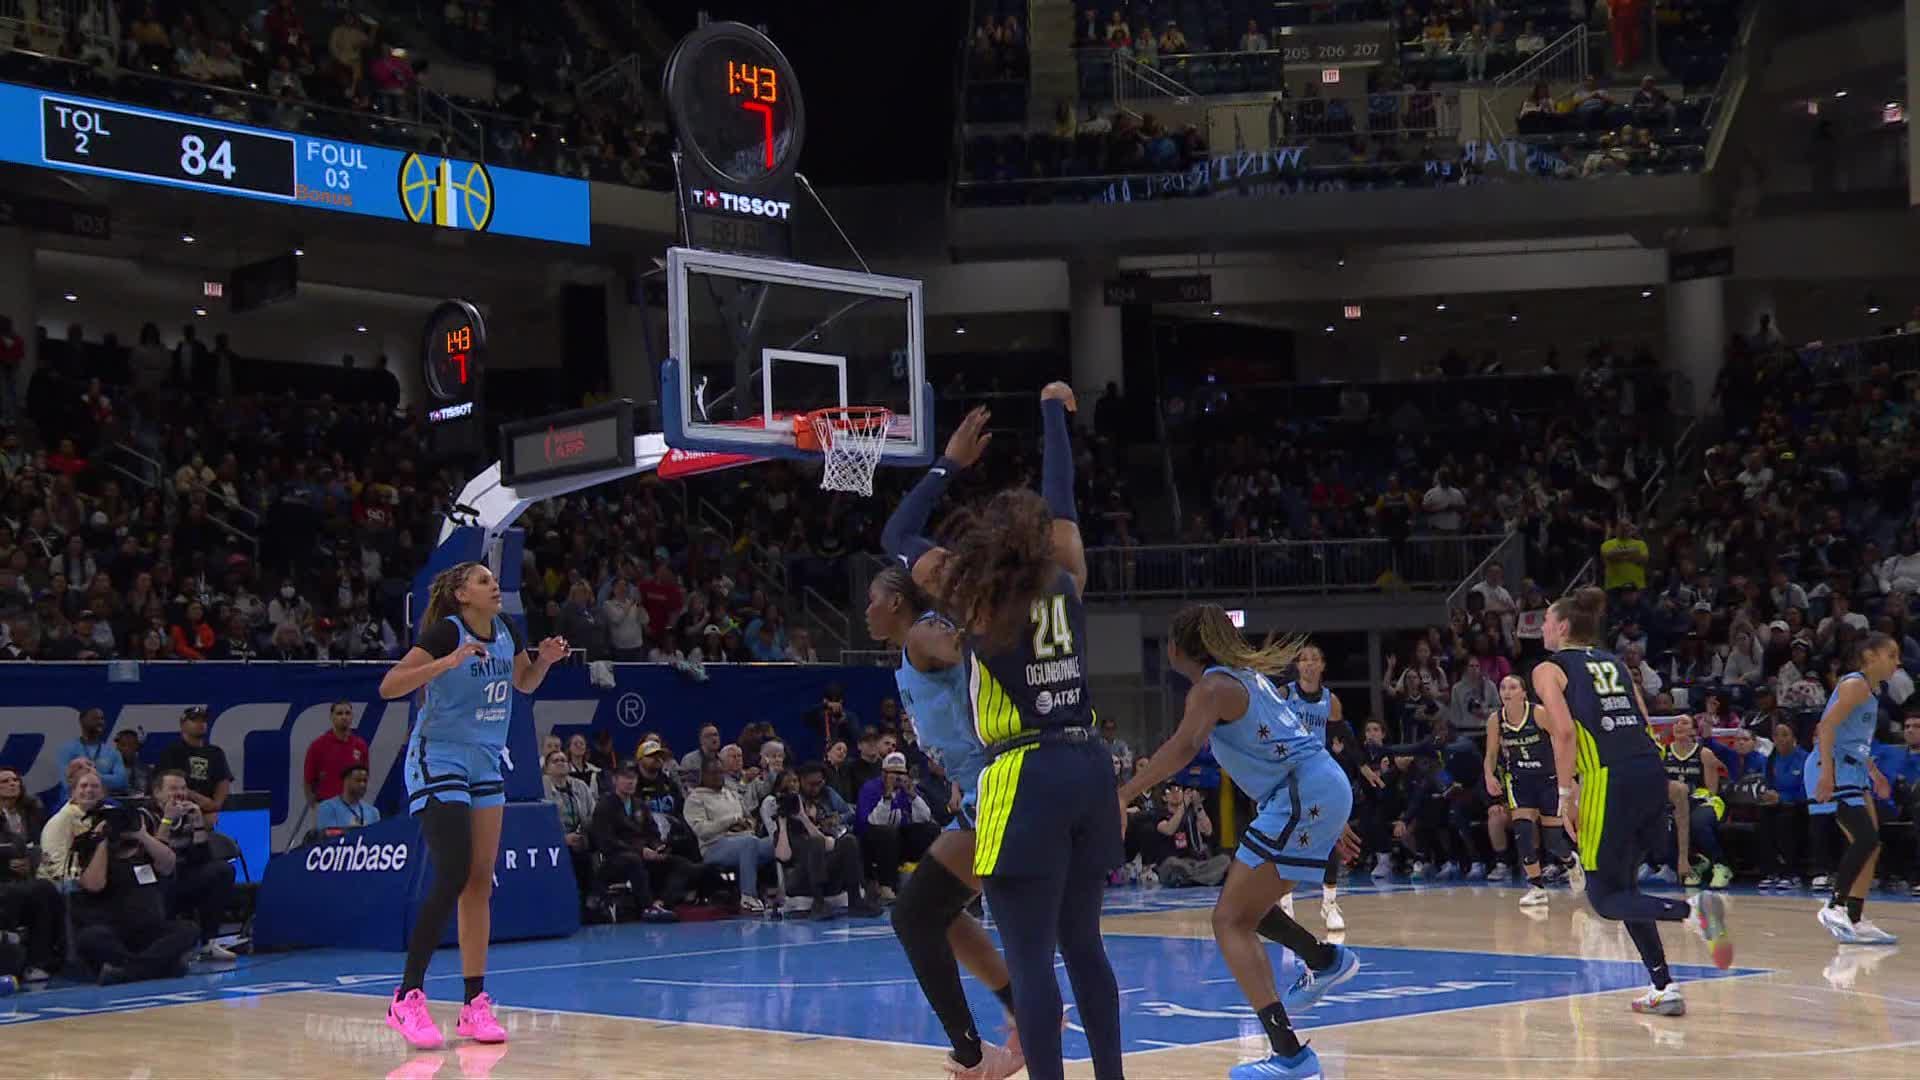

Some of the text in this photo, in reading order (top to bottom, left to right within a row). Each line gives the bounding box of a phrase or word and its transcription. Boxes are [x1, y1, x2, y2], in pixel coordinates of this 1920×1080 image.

[728, 60, 776, 103] 1:43
[55, 105, 111, 136] TOL
[741, 101, 773, 170] 7
[74, 132, 89, 154] 2
[180, 134, 237, 180] 84
[307, 142, 368, 170] FOUL
[325, 167, 350, 190] 03
[296, 183, 353, 207] Bonus
[719, 190, 791, 220] TISSOT
[446, 326, 471, 353] 1:43
[451, 354, 468, 385] 7
[440, 401, 473, 419] TISSOT
[1030, 594, 1073, 660] 24
[1025, 655, 1081, 686] OGUNBOWALE
[1585, 661, 1626, 696] 32
[483, 680, 509, 704] 10
[1053, 687, 1081, 708] AT&T
[305, 836, 408, 873] coinbase
[505, 847, 560, 869] RTY
